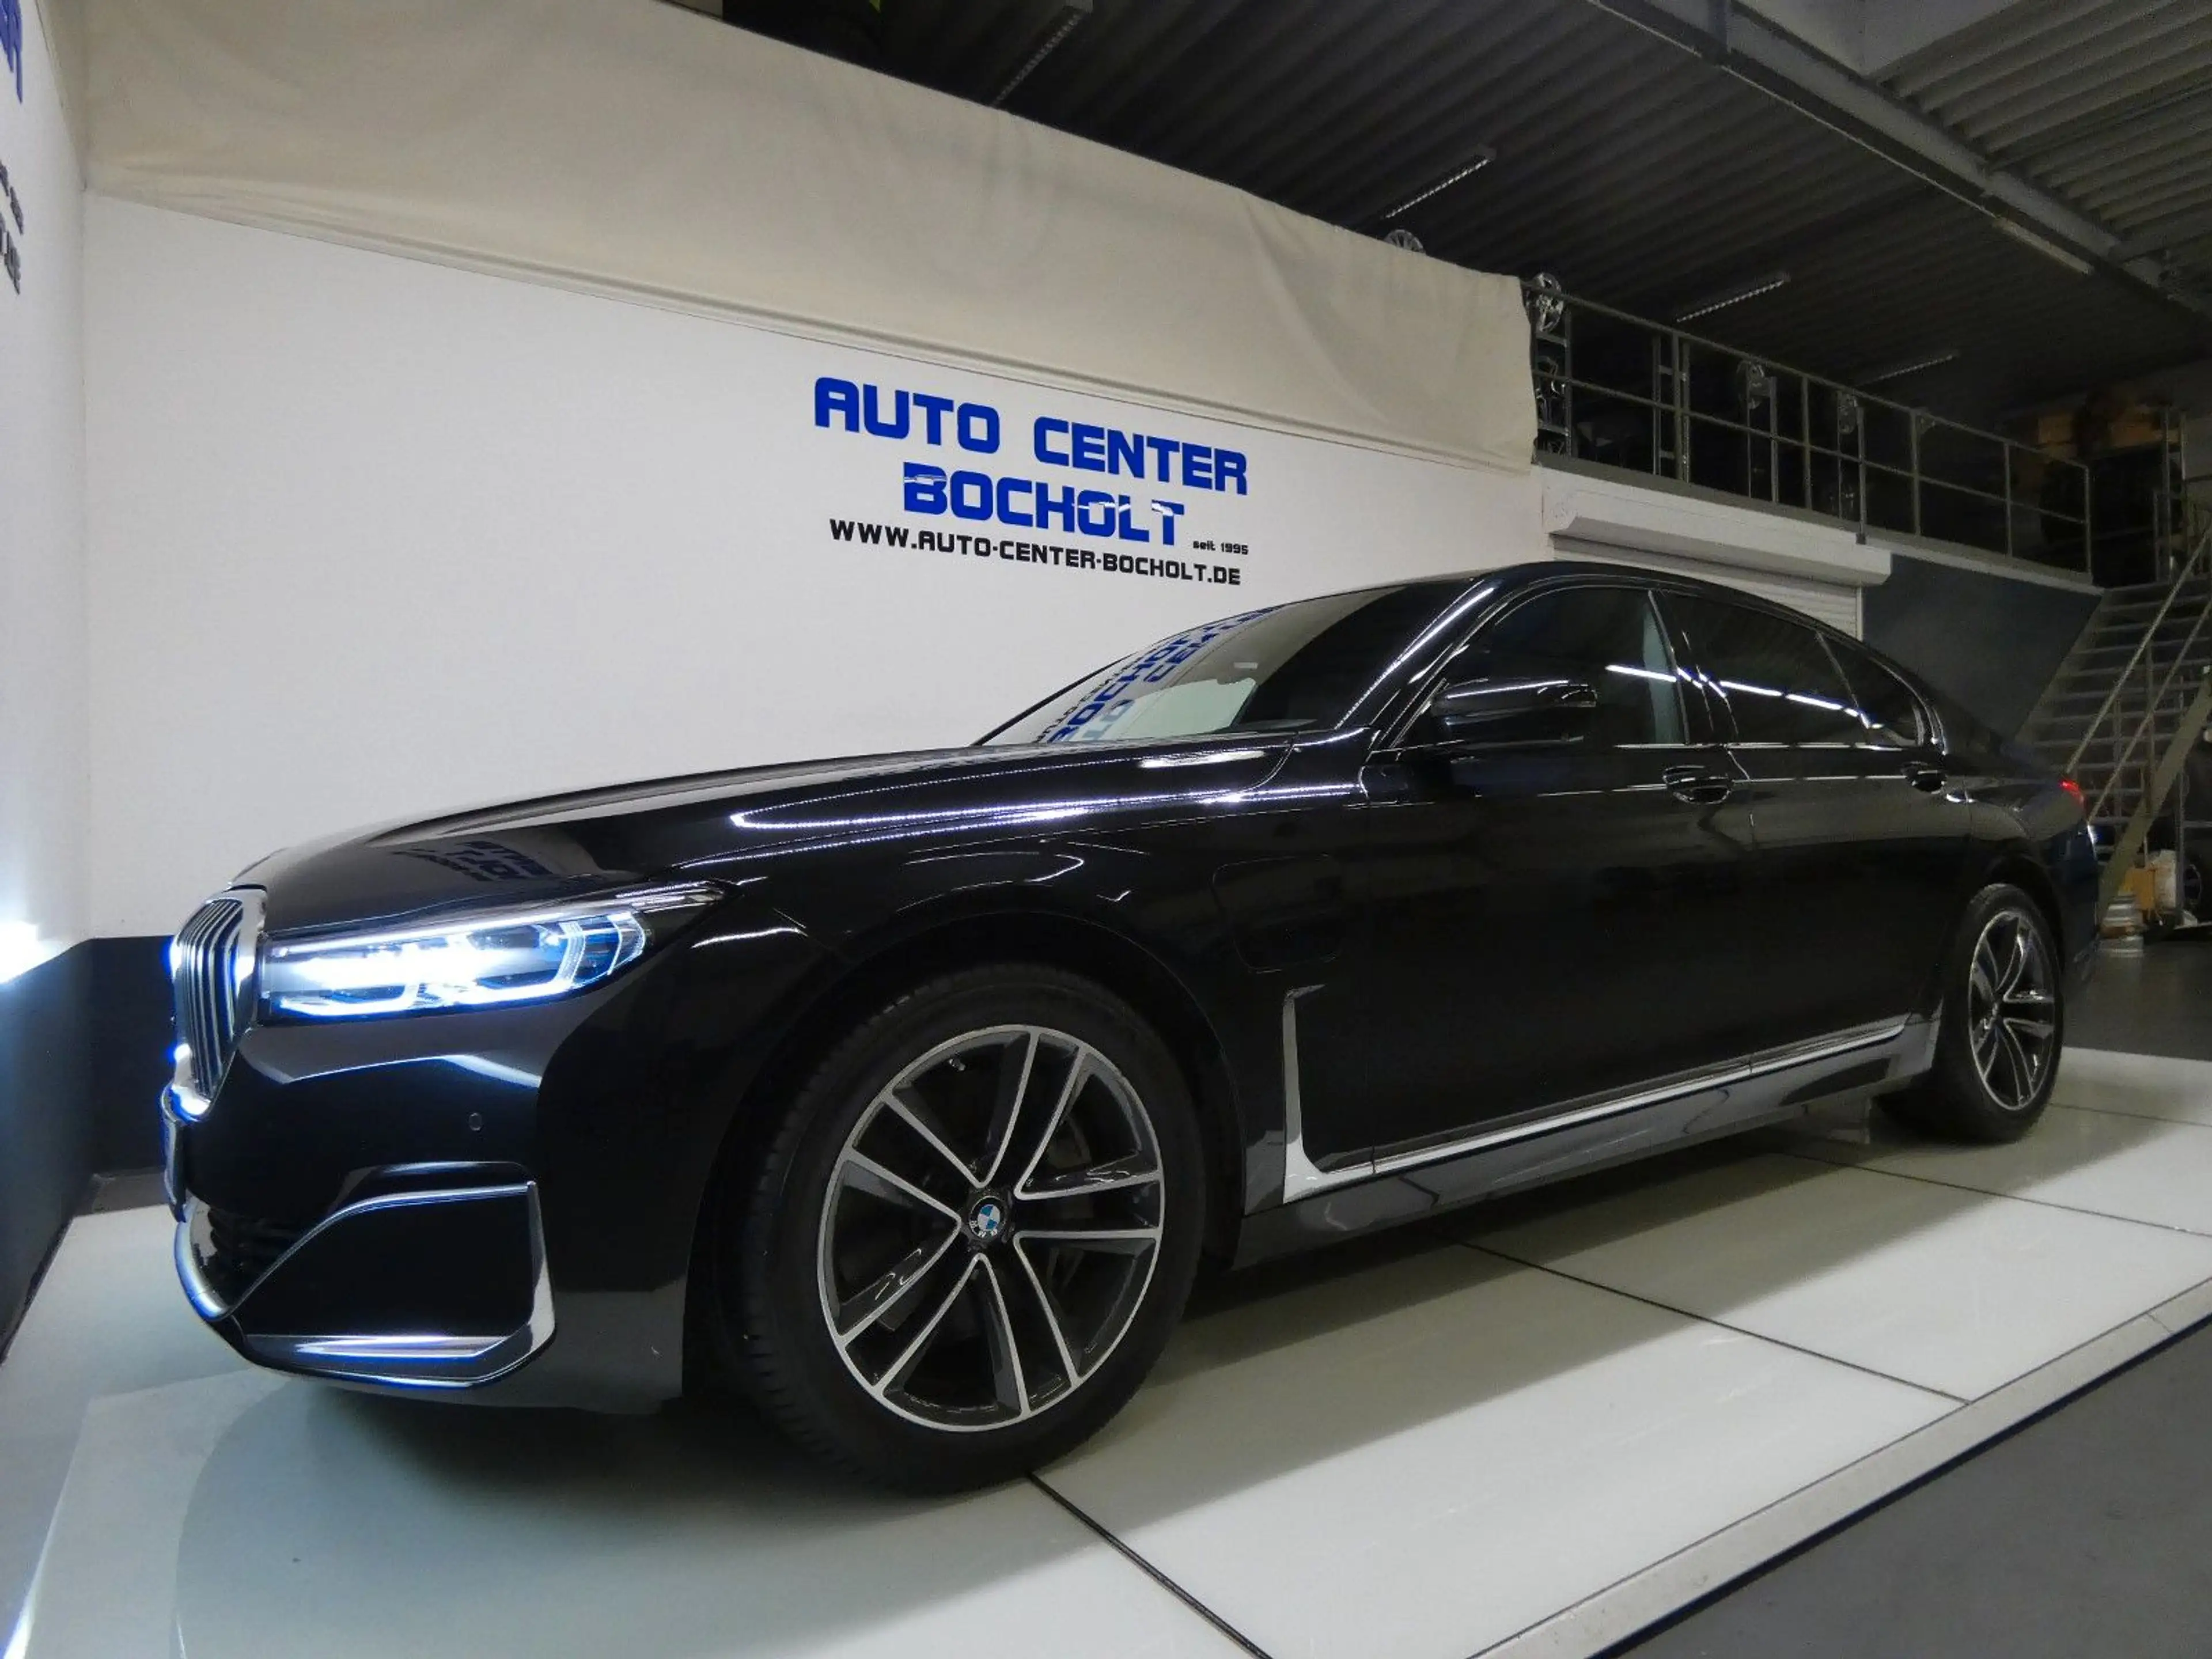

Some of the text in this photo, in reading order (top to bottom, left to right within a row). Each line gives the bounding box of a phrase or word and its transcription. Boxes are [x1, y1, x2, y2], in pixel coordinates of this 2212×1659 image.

[814, 376, 1248, 495] AUTO CENTER
[903, 461, 1186, 546] BOCHOLT
[1221, 542, 1248, 555] 1995
